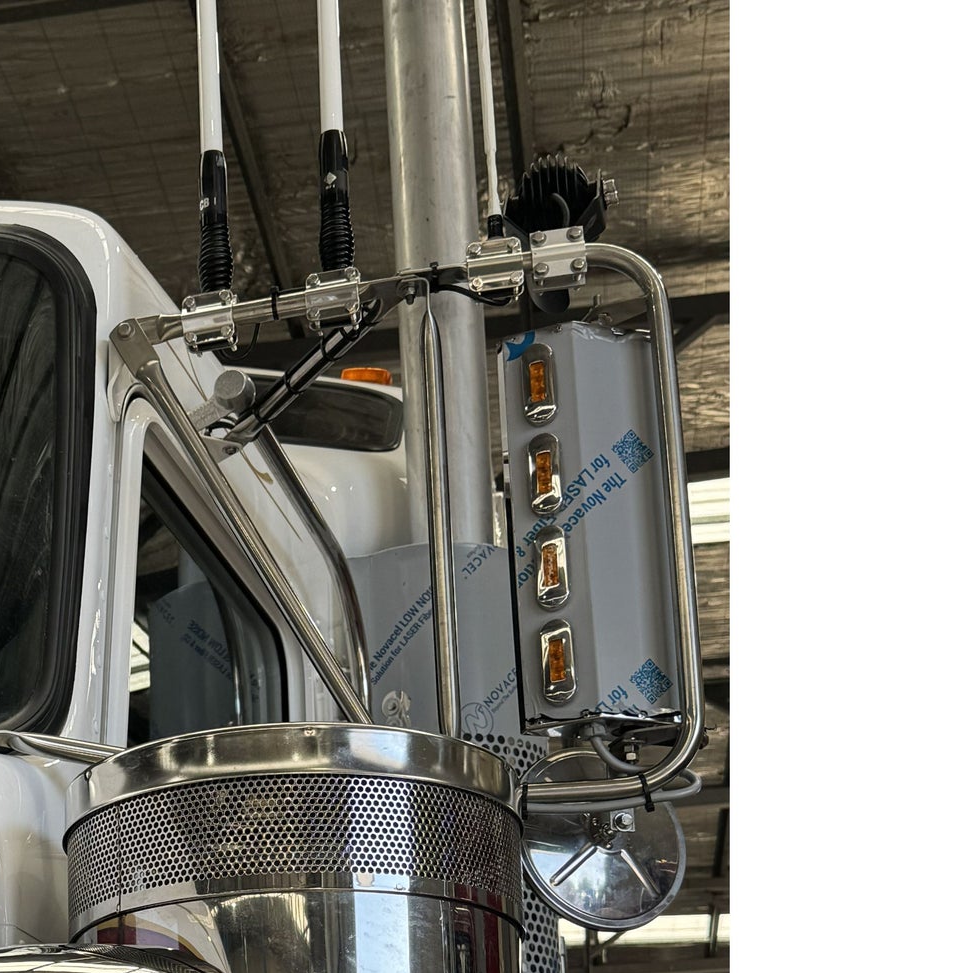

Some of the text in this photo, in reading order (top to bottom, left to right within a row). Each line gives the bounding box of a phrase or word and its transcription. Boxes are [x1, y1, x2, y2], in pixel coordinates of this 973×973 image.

[591, 453, 611, 472] for
[560, 468, 595, 511] LASE
[562, 472, 627, 535] The Novace
[462, 545, 495, 576] VACEL
[370, 654, 395, 686] Solution
[391, 644, 403, 657] for
[399, 621, 422, 647] LASER
[373, 624, 403, 662] Novacel
[399, 604, 420, 627] LOW
[607, 685, 629, 705] for
